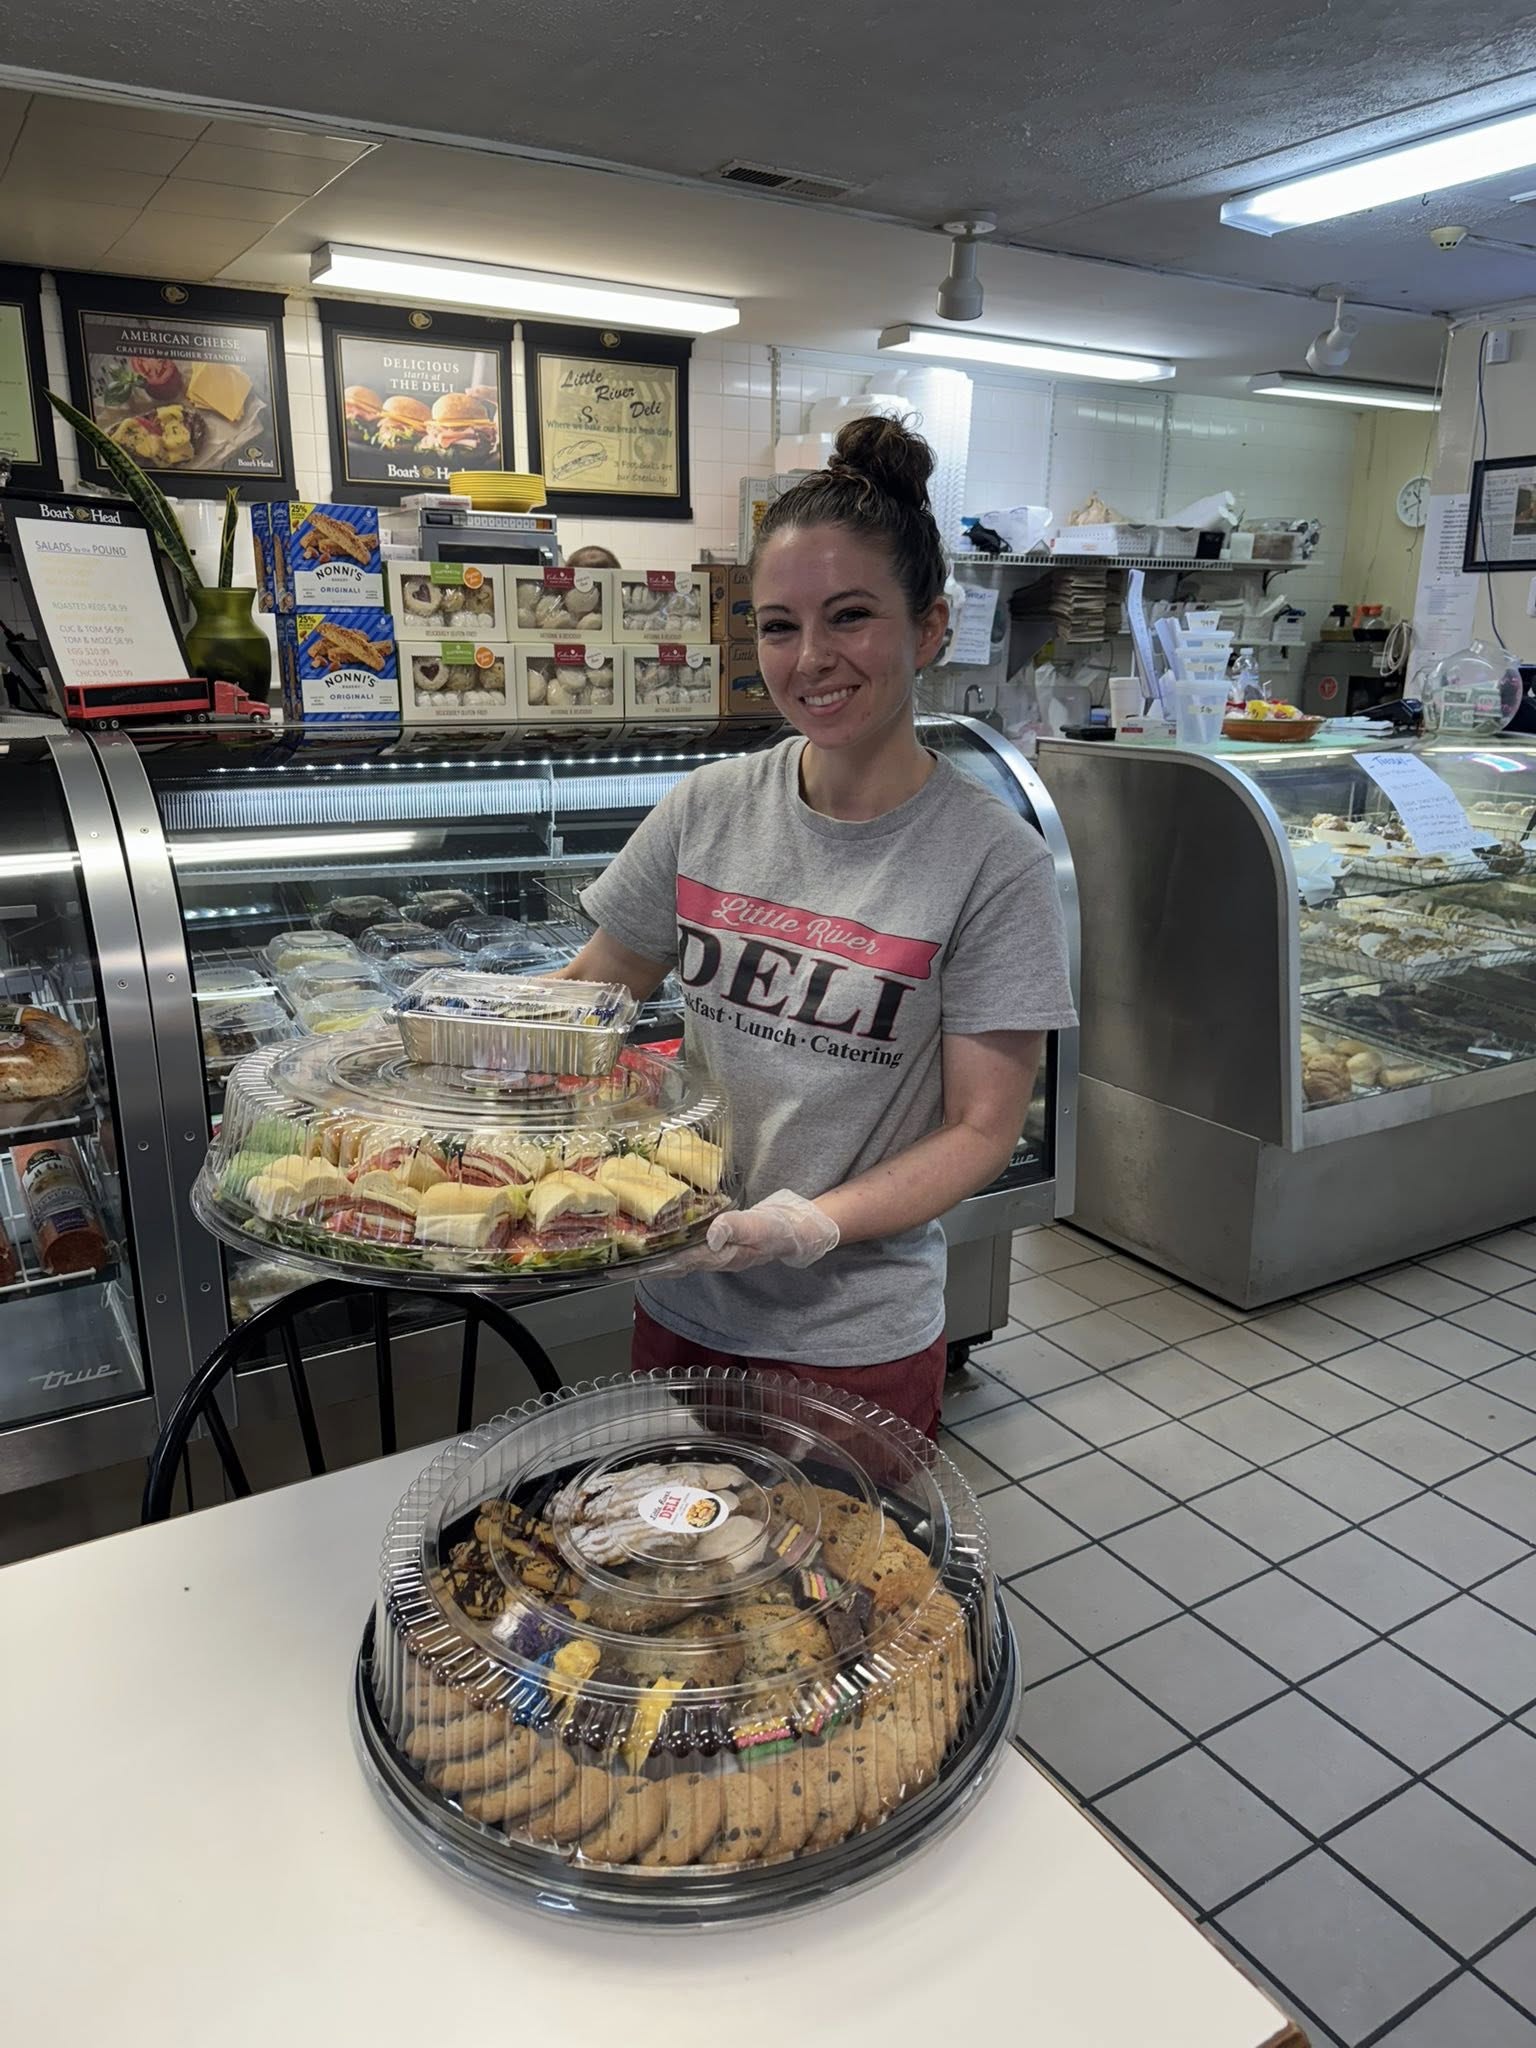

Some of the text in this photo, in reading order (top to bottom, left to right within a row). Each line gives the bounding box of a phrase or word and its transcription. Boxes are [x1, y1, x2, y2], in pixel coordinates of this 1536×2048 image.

[120, 329, 240, 350] AMERICAN CHEESE
[116, 345, 155, 354] CRAFTED
[170, 349, 202, 359] HIGHER
[203, 352, 247, 362] STANDARD
[383, 356, 460, 374] DELICIOUS
[403, 370, 429, 380] starts
[561, 368, 604, 389] Little
[390, 378, 455, 393] THE DELI
[594, 384, 636, 404] River
[629, 400, 662, 419] Deli
[546, 418, 570, 431] Where
[387, 463, 420, 479] Boar's
[39, 503, 122, 525] Boar's Head
[291, 504, 307, 513] 25%
[35, 540, 72, 552] SALADS
[92, 544, 127, 556] POUND
[315, 565, 363, 582] NONNI'S
[298, 615, 316, 624] 25%
[324, 672, 377, 688] NONNI'S
[711, 895, 881, 956] Little River
[678, 924, 917, 1042] DELI
[735, 1011, 797, 1048] Lunch
[810, 1034, 905, 1069] Catering
[659, 1496, 681, 1519] DELI
